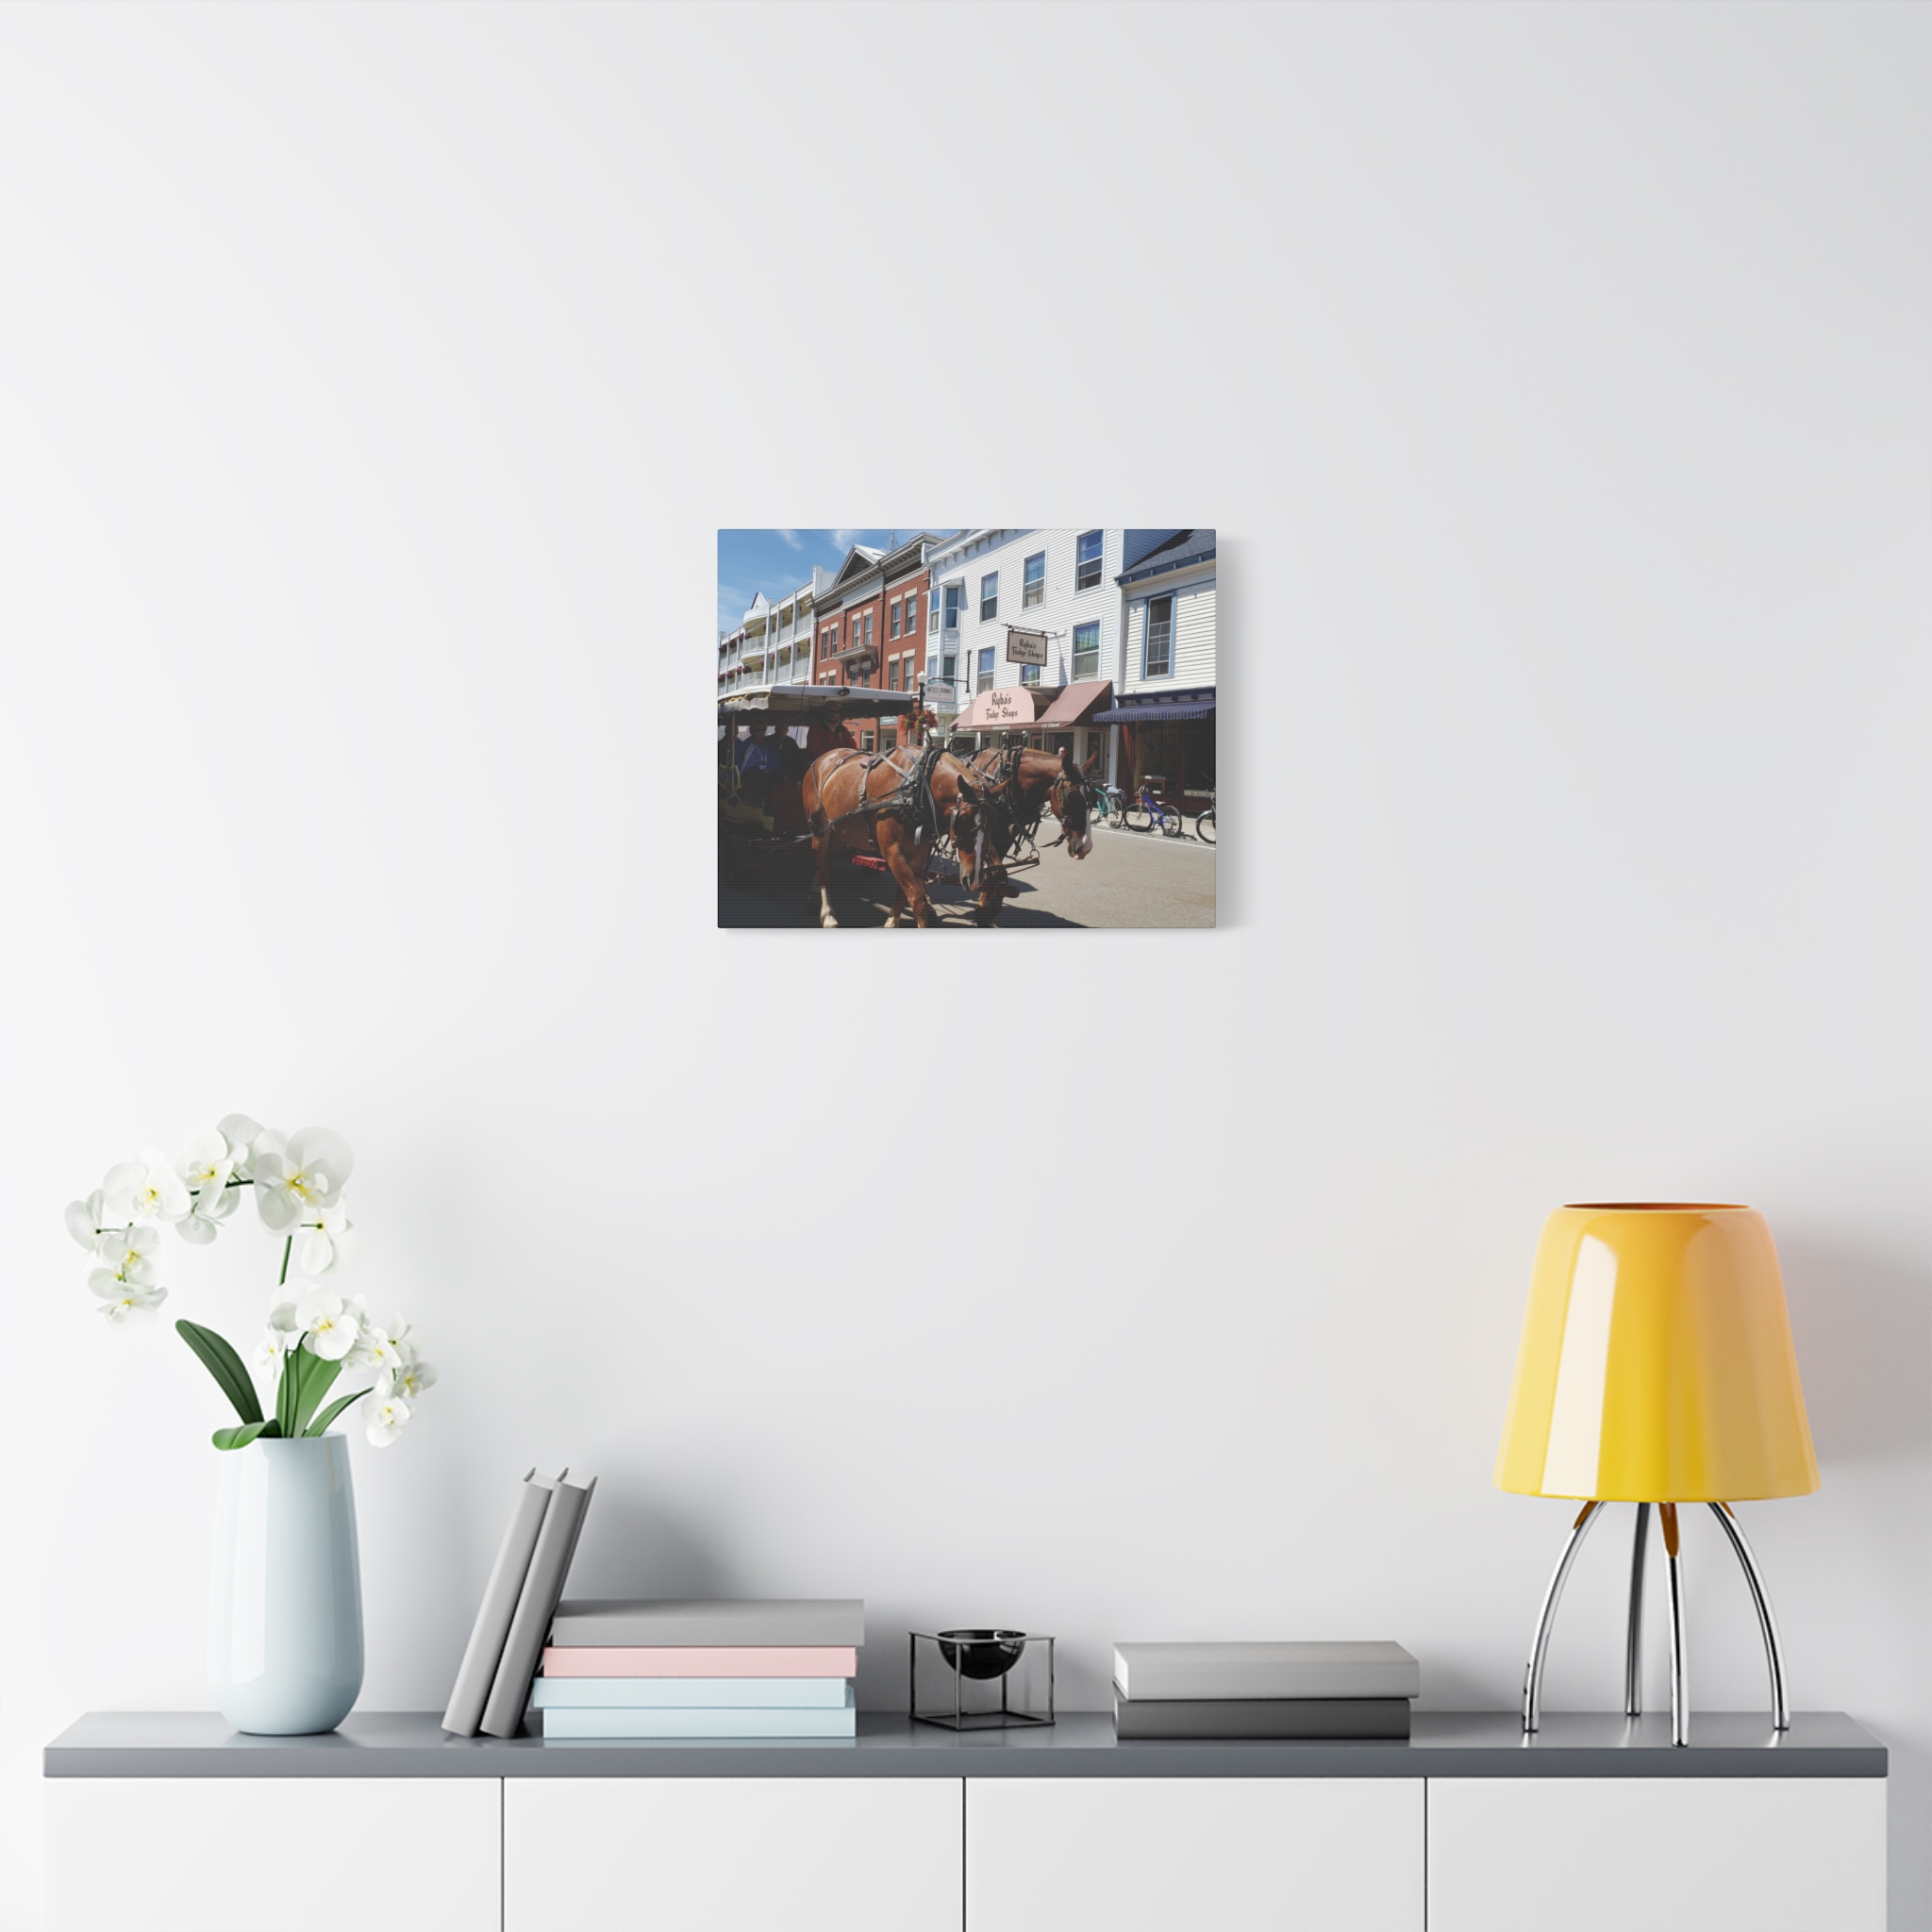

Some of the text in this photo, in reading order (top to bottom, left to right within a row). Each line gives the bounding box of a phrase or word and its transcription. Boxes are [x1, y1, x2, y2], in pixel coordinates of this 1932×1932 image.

[1011, 646, 1043, 659] Fudge Shops
[991, 691, 1012, 709] Ryba's
[986, 707, 1018, 721] Fudge Shops
